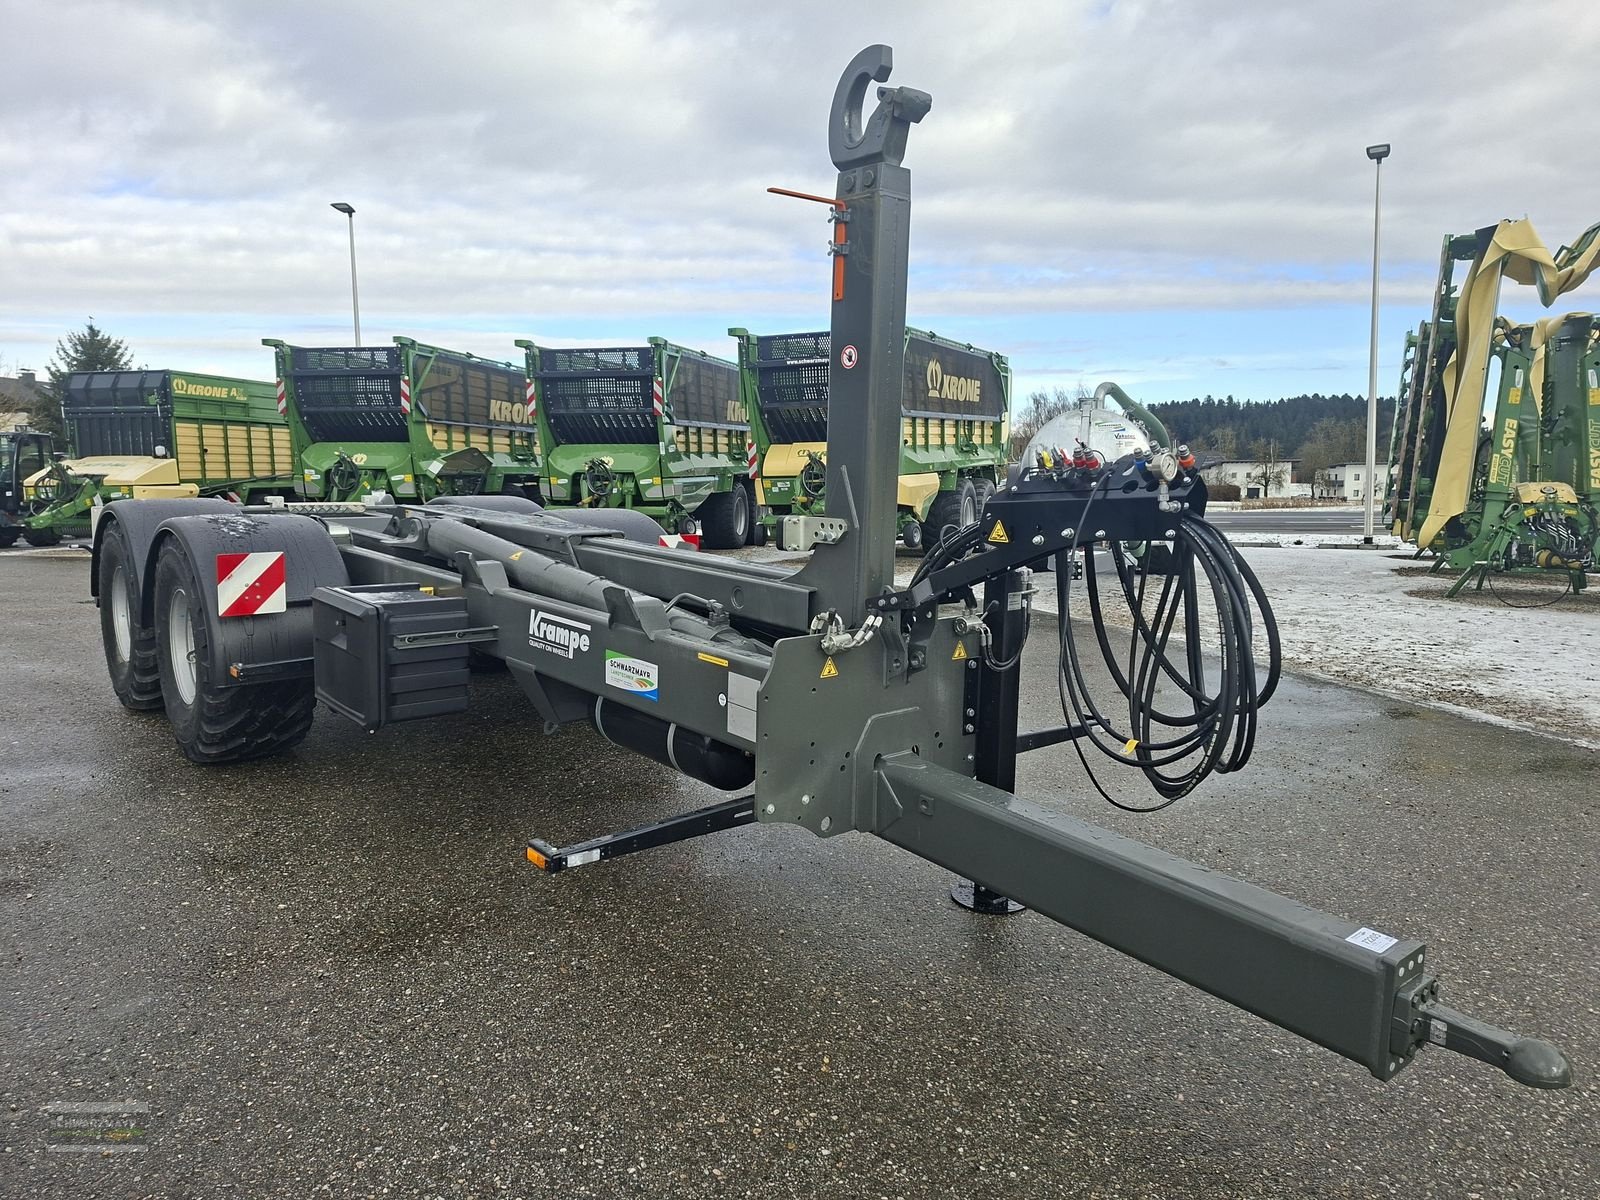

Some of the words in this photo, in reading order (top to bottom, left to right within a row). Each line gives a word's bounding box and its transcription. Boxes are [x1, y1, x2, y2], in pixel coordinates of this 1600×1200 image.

[187, 384, 228, 398] KRONE
[941, 374, 981, 402] KRONE
[1496, 418, 1518, 487] EASYCUT
[529, 608, 591, 659] Krampe
[528, 639, 545, 650] QUALITY
[545, 644, 553, 652] ON
[552, 647, 569, 658] WHEELS
[609, 659, 651, 679] SCHWARZMAYR
